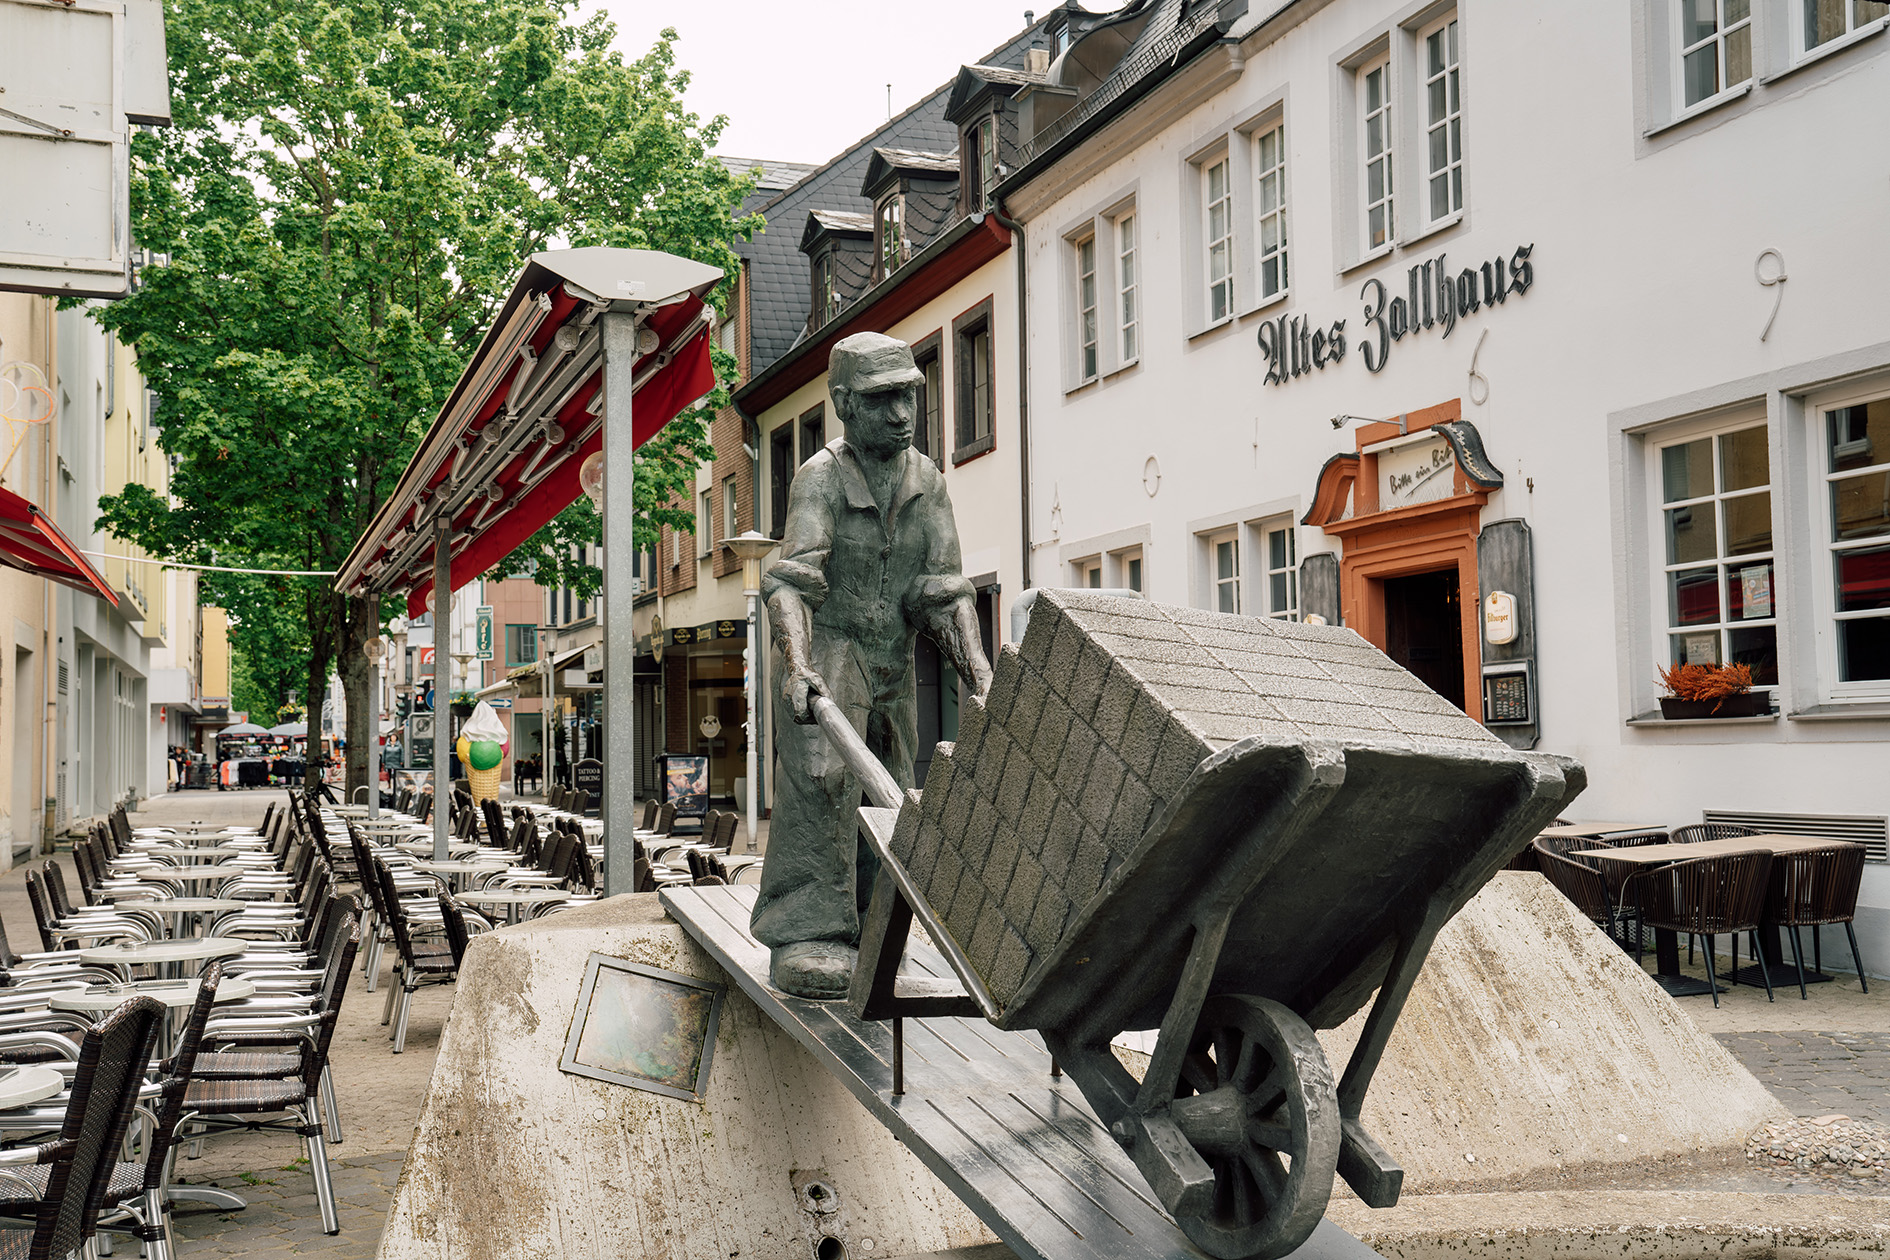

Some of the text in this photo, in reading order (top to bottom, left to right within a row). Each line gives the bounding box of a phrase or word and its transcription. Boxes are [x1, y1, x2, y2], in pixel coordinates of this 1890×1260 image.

[1257, 243, 1534, 386] Altes Zollhaus
[1389, 474, 1412, 494] Bitte
[1415, 465, 1431, 479] ein
